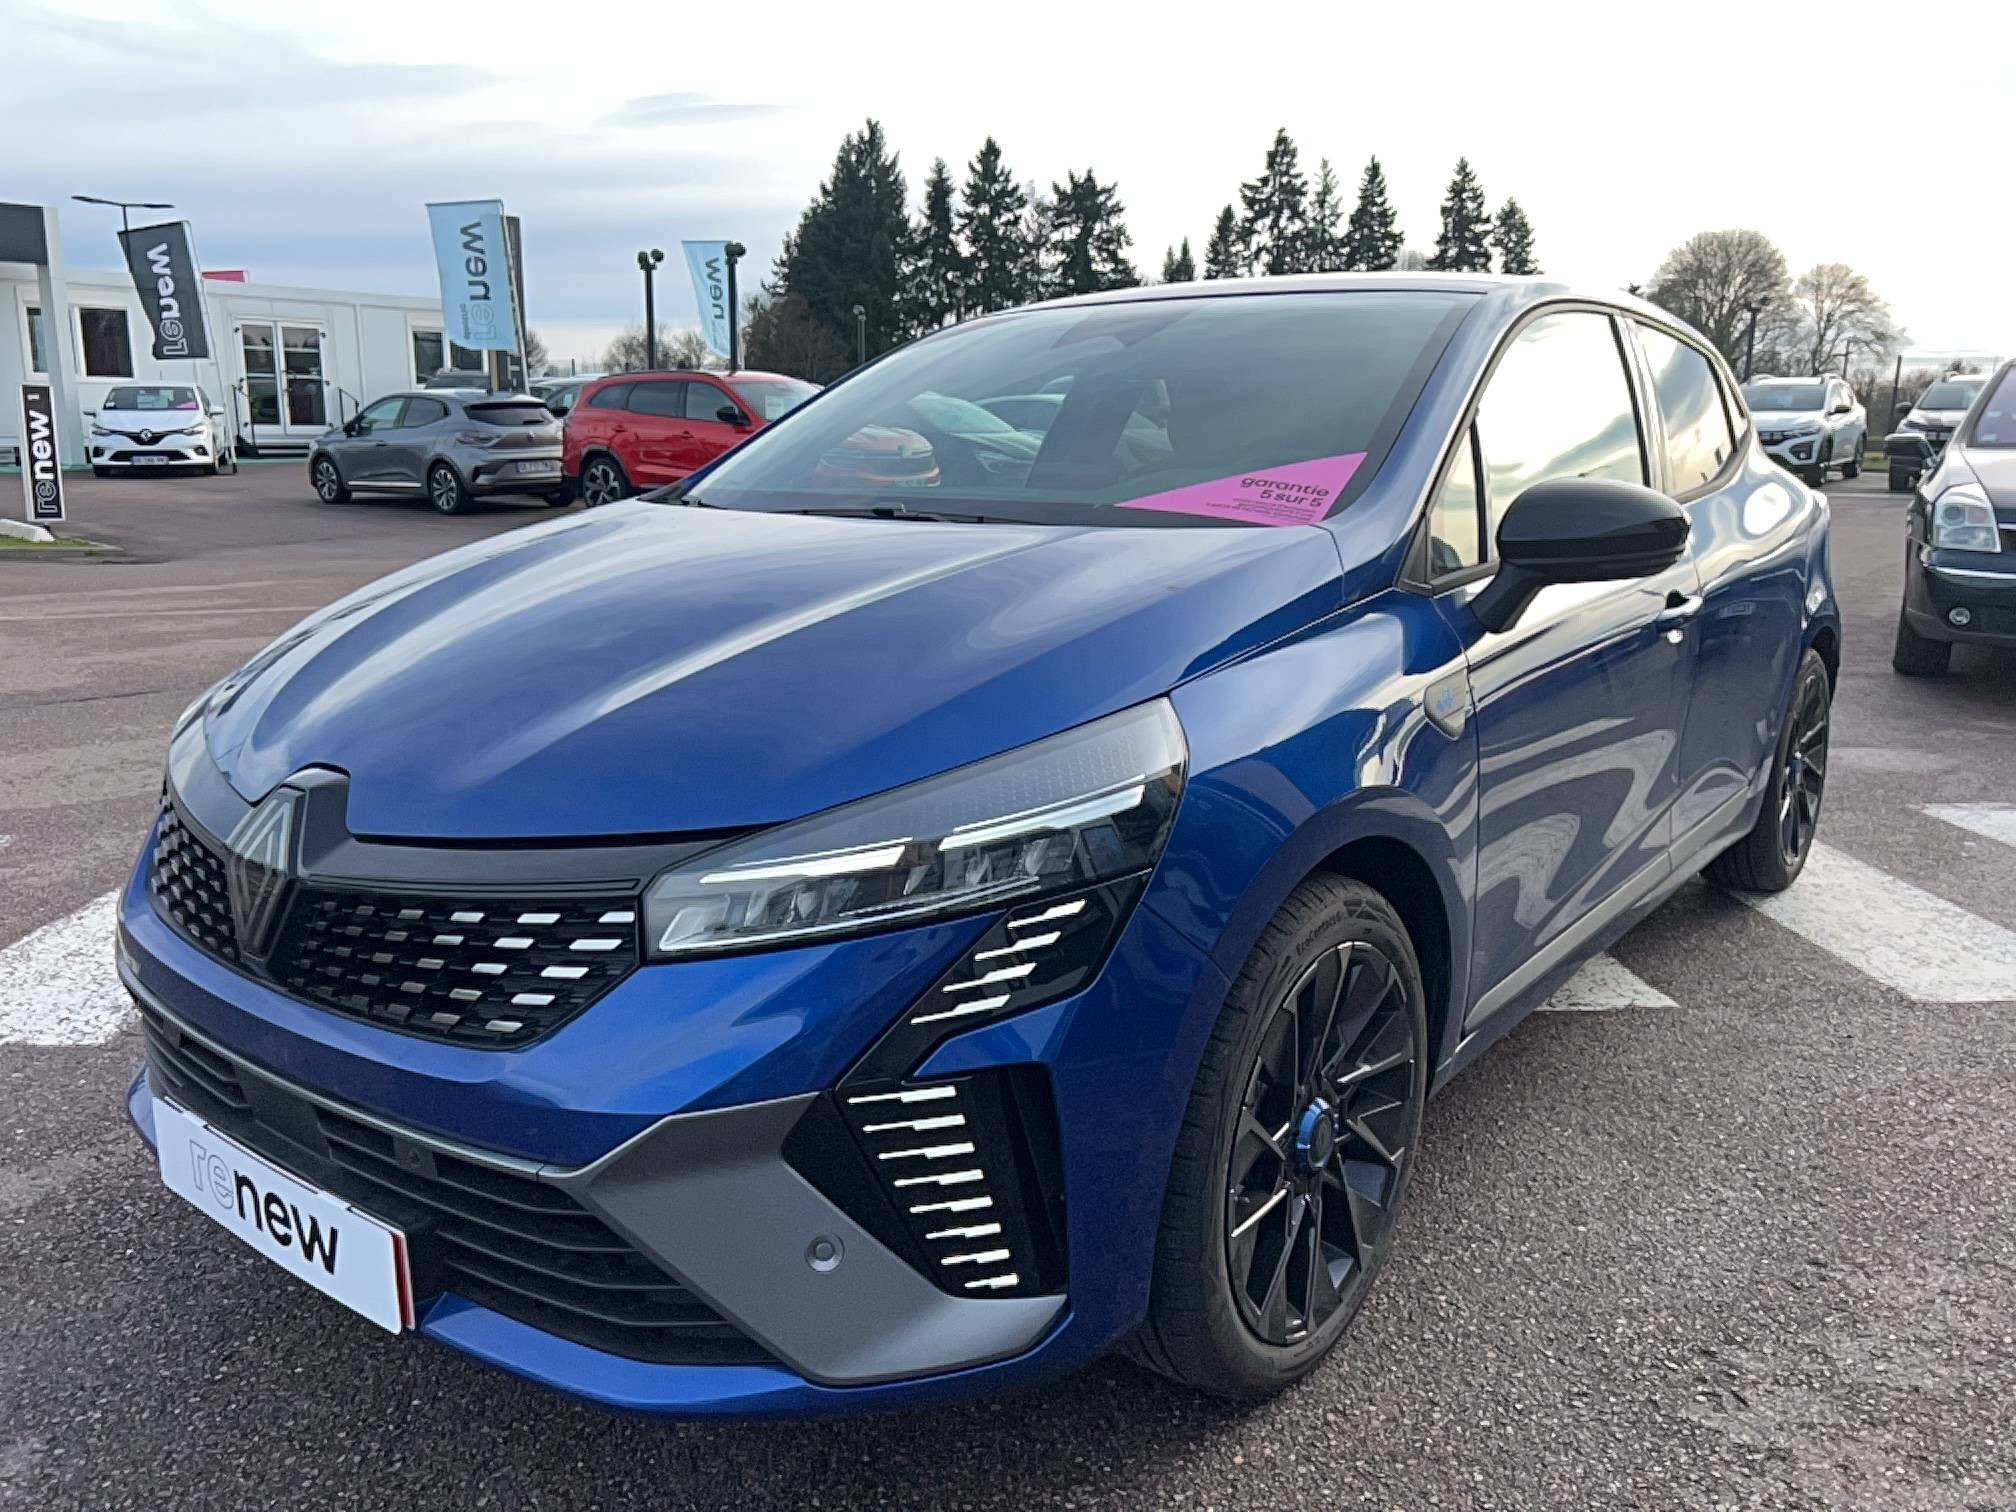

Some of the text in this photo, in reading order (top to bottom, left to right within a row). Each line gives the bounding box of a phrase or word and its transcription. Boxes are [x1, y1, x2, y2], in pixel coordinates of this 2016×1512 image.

[28, 410, 59, 514] renew
[1240, 478, 1330, 497] garantie
[1260, 489, 1325, 508] 5 sur 5
[189, 1139, 338, 1275] renew
